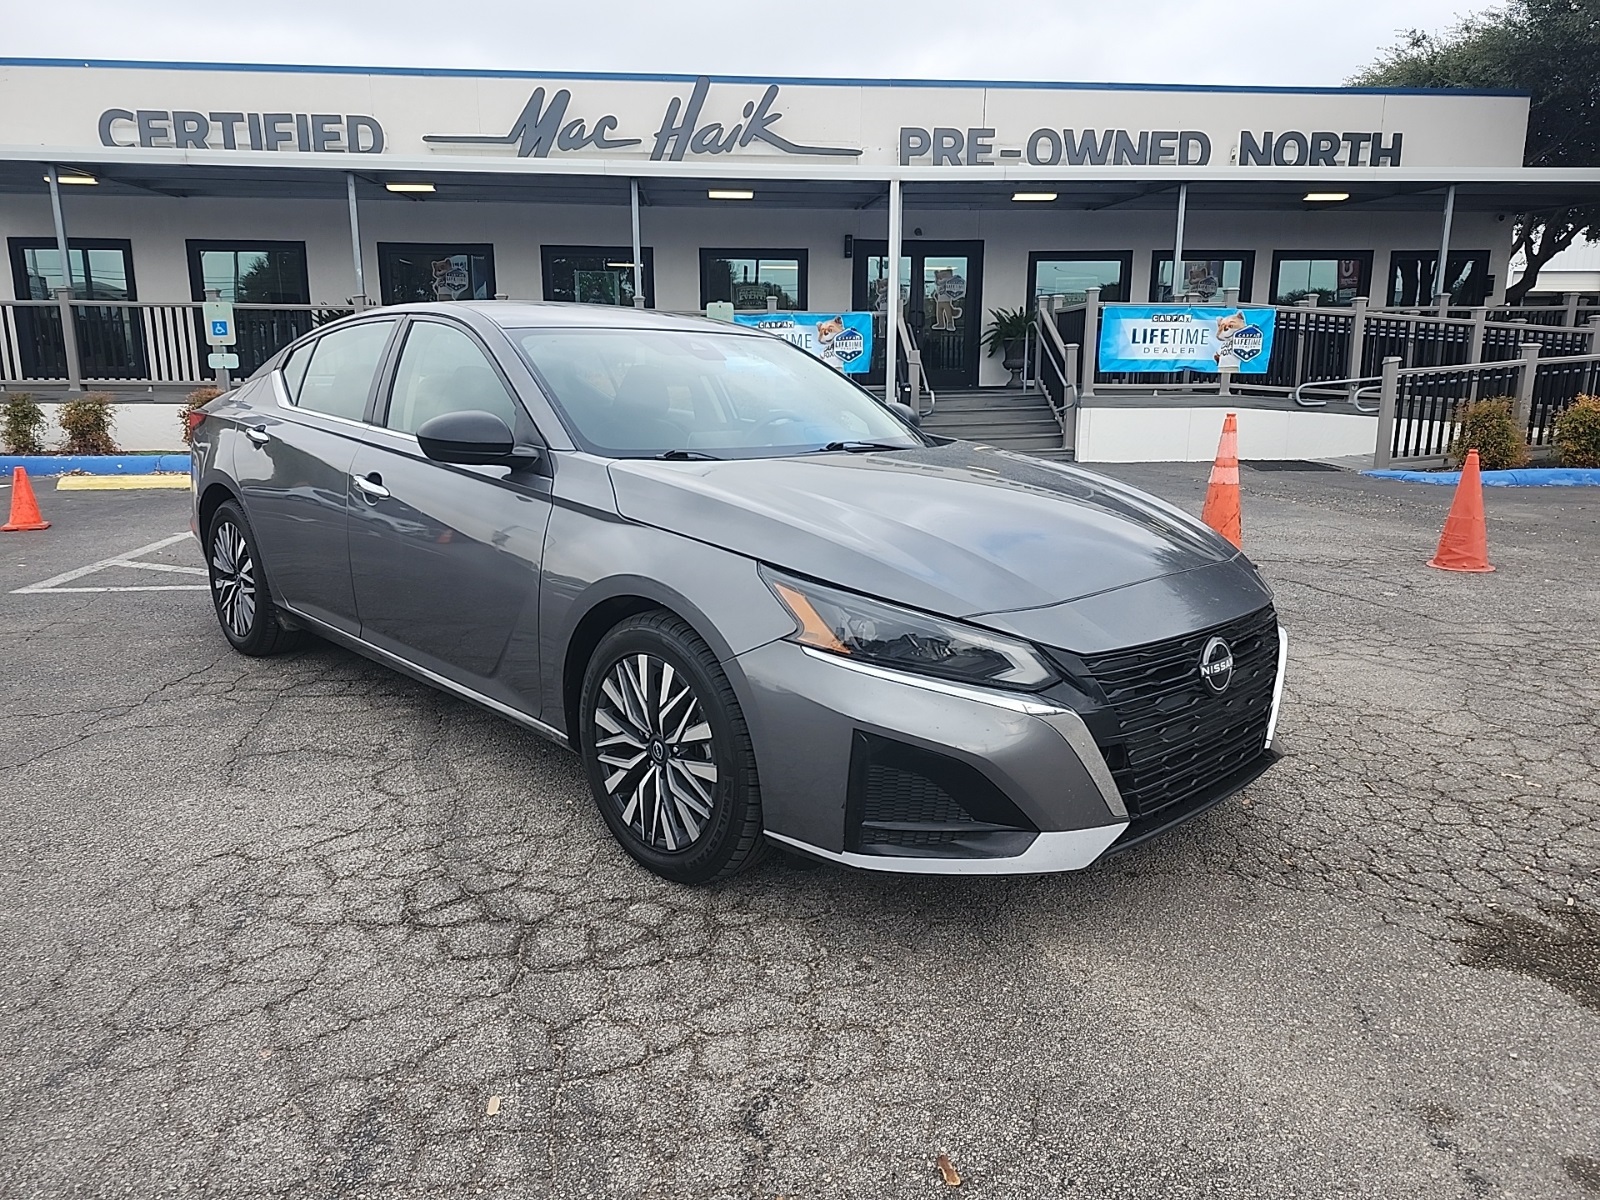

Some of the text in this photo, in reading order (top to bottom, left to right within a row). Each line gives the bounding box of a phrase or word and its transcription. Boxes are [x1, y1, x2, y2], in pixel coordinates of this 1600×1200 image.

[98, 108, 385, 154] CERTIFIED
[899, 127, 1404, 167] PRE-OWNED NORTH
[758, 320, 795, 329] CARFAX
[1152, 314, 1192, 323] CARFAX
[1131, 328, 1210, 345] LIFETIME
[1234, 338, 1262, 346] LIFETIME
